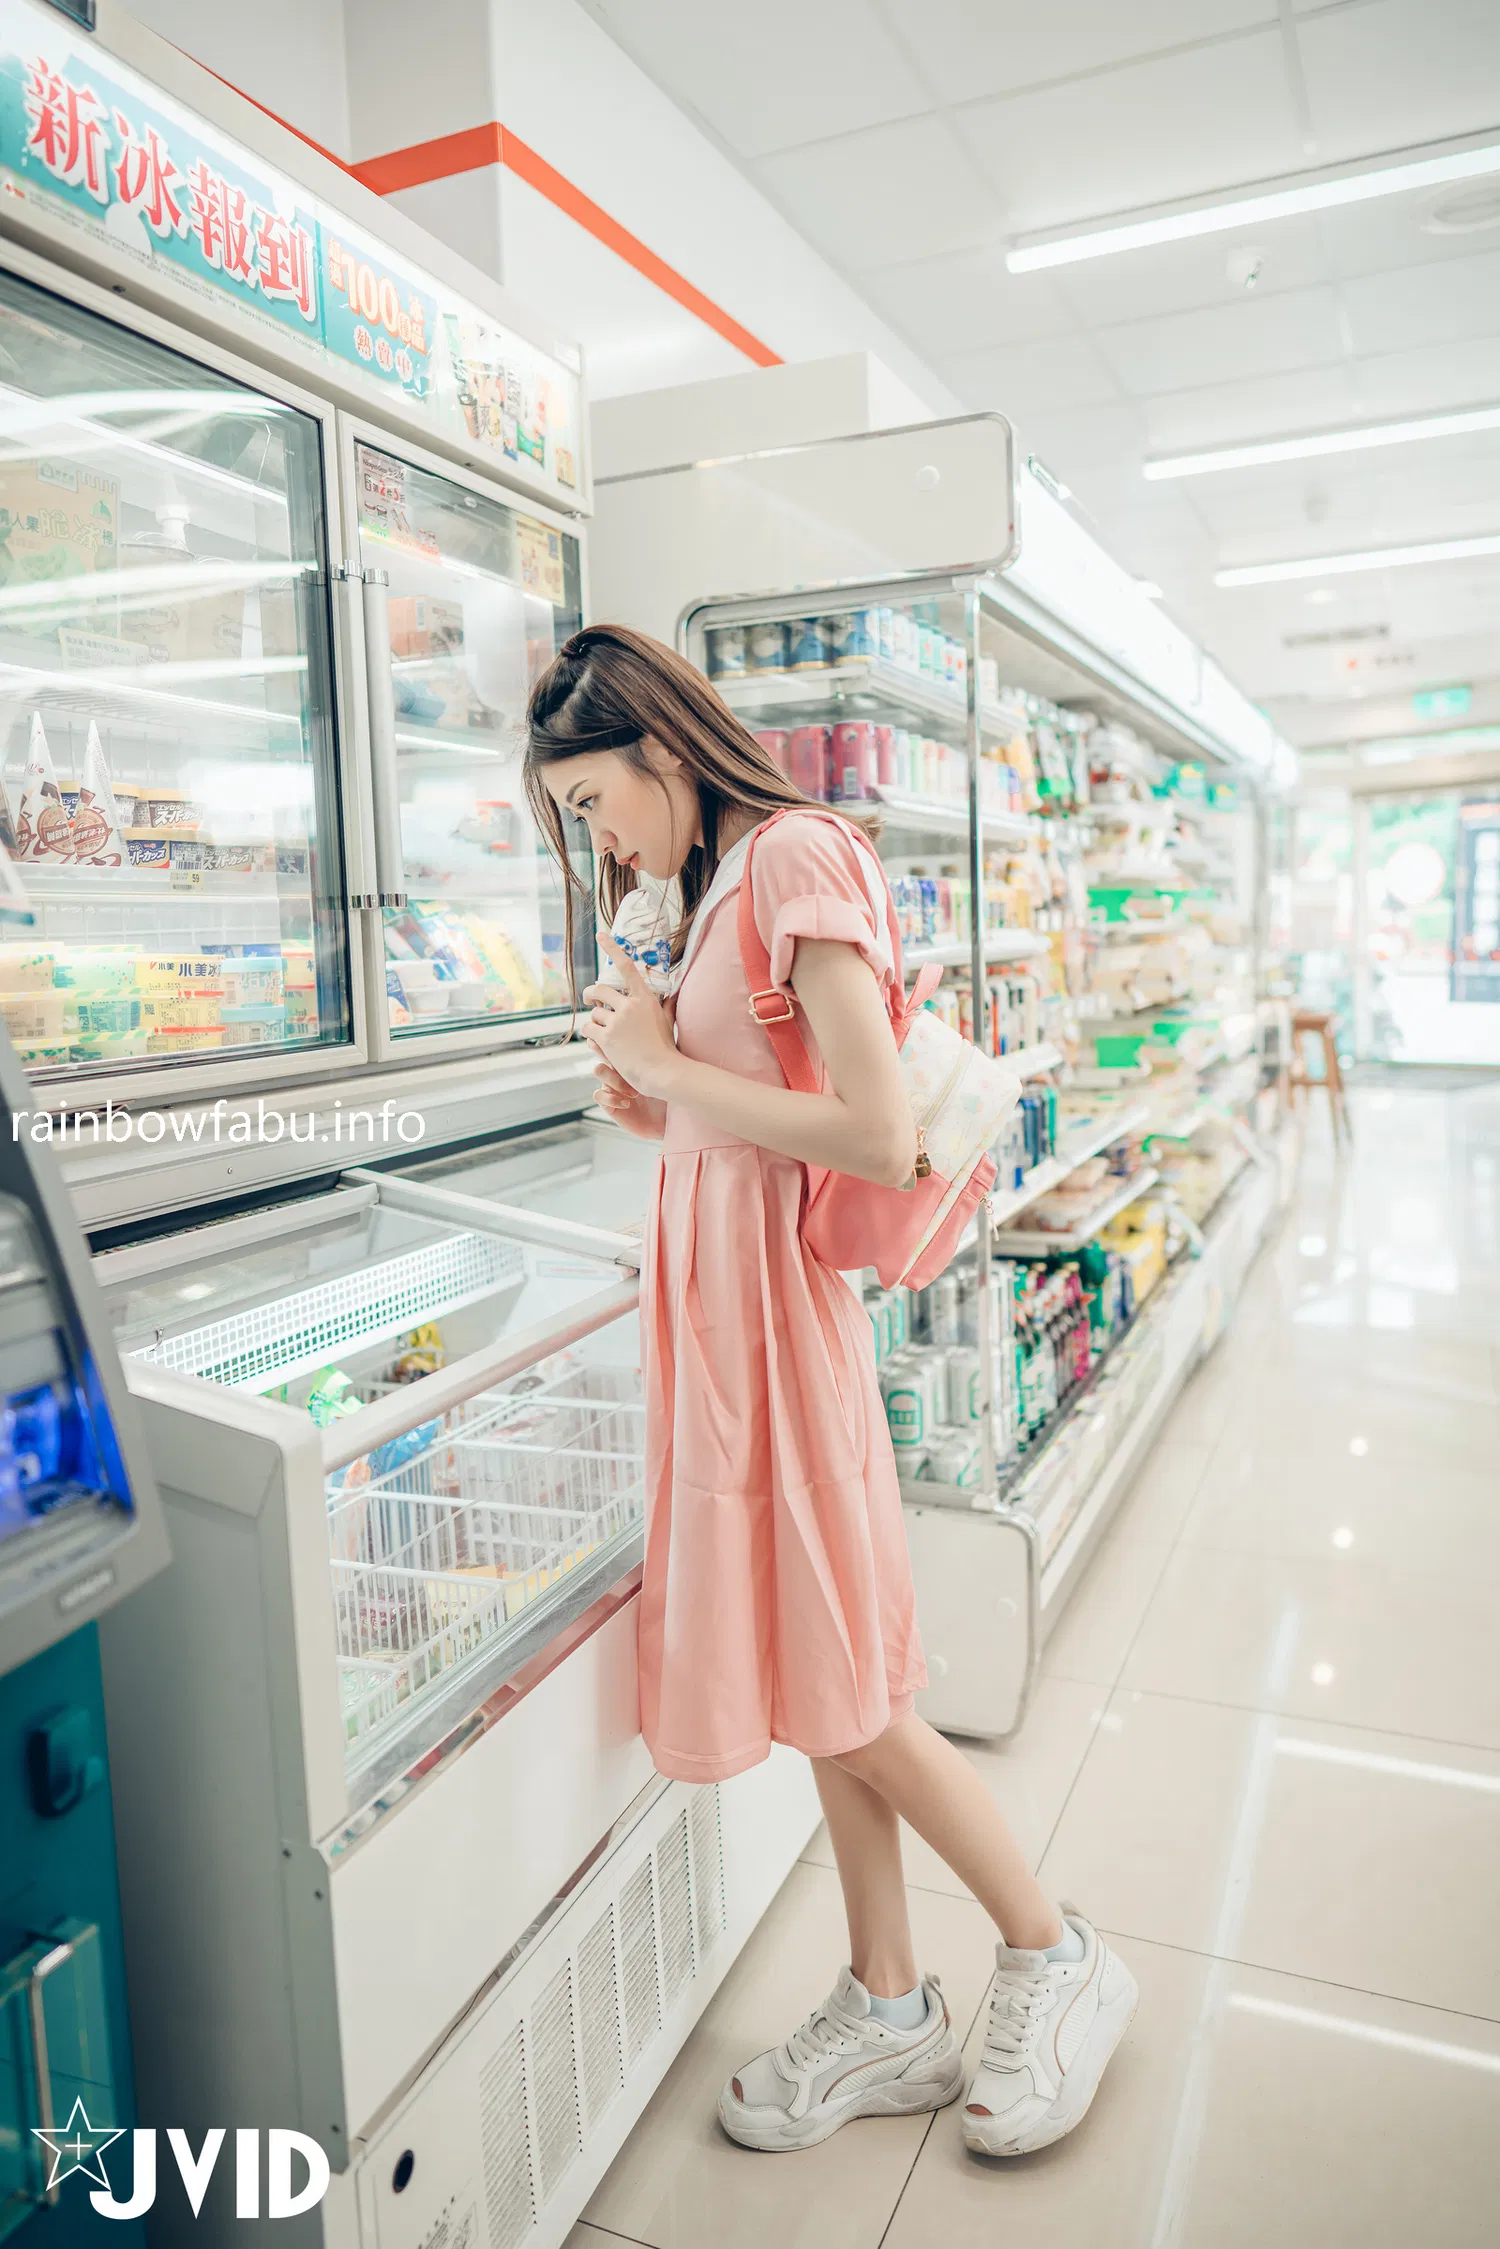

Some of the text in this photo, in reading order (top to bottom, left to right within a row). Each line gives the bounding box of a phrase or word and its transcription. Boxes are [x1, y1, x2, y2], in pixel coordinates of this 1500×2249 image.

[22, 55, 311, 313] 新冰報到
[192, 873, 200, 883] 59
[158, 962, 175, 971] 小美
